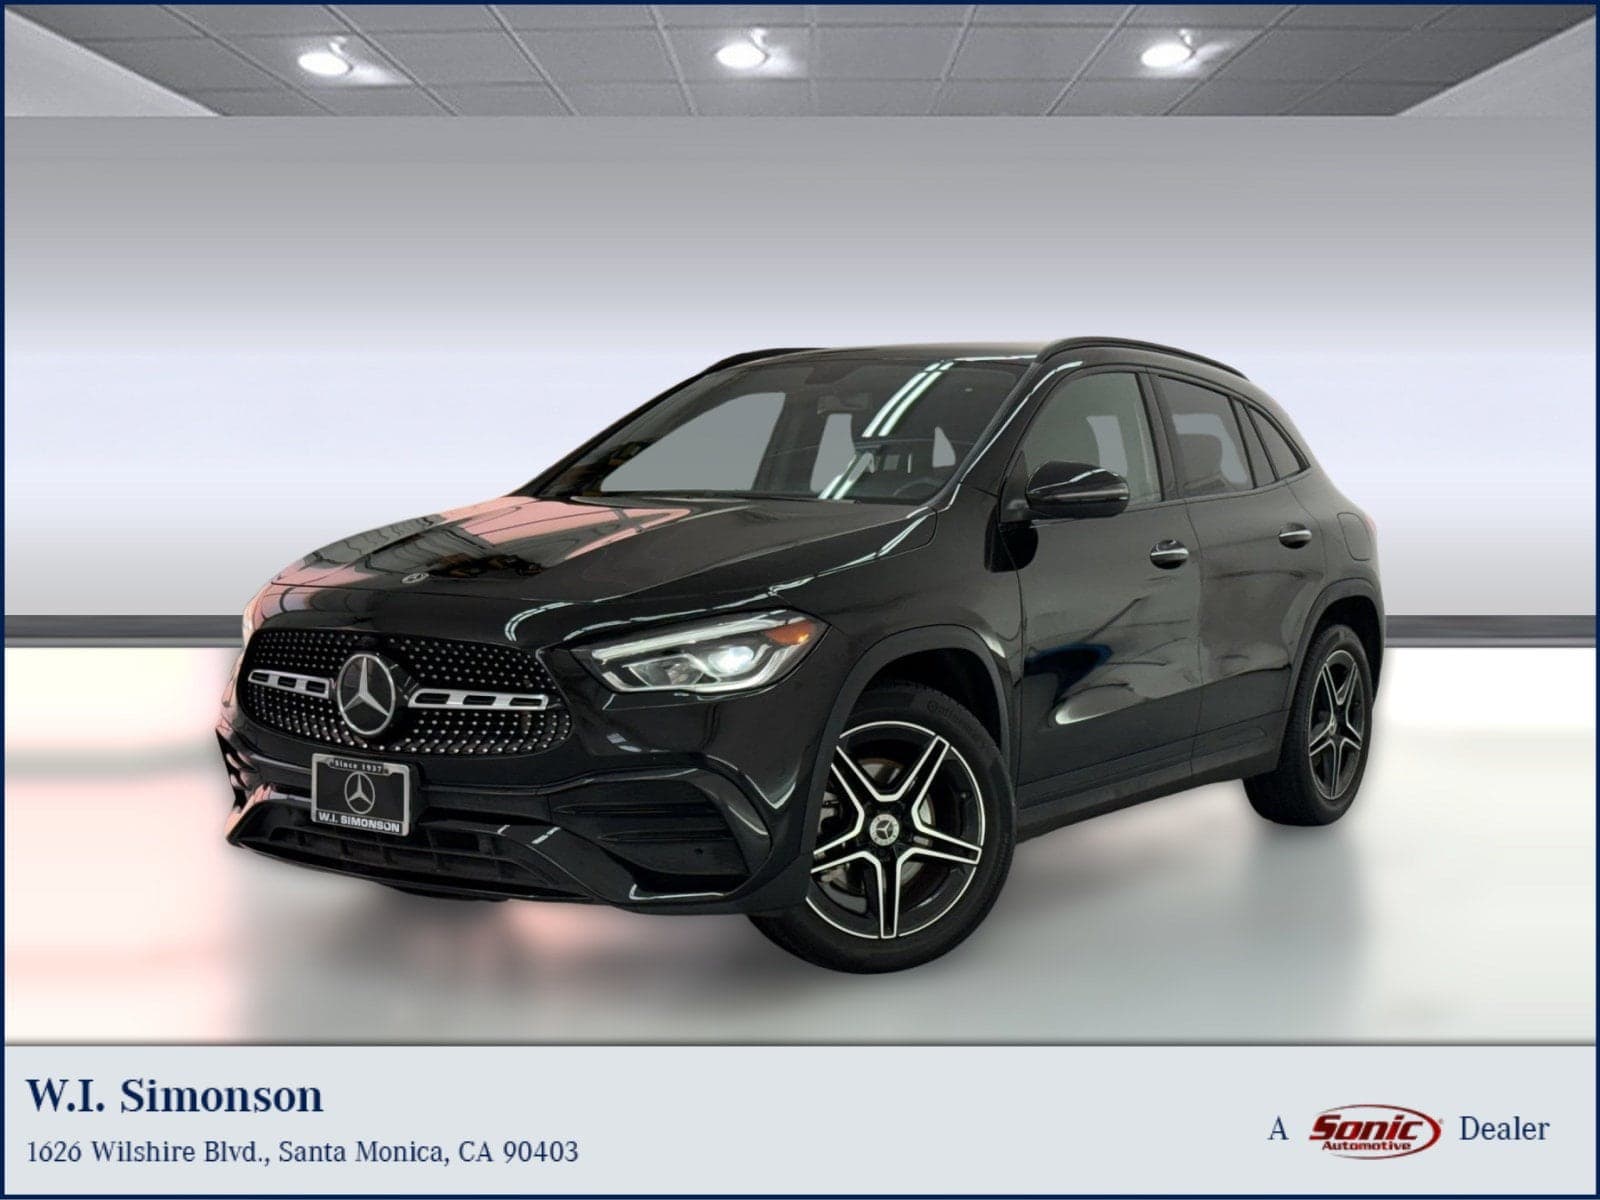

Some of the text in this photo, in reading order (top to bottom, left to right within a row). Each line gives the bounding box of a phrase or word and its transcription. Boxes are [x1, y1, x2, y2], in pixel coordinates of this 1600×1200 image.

[334, 760, 382, 772] Since 1937
[318, 811, 400, 833] W.I. SIMONSON
